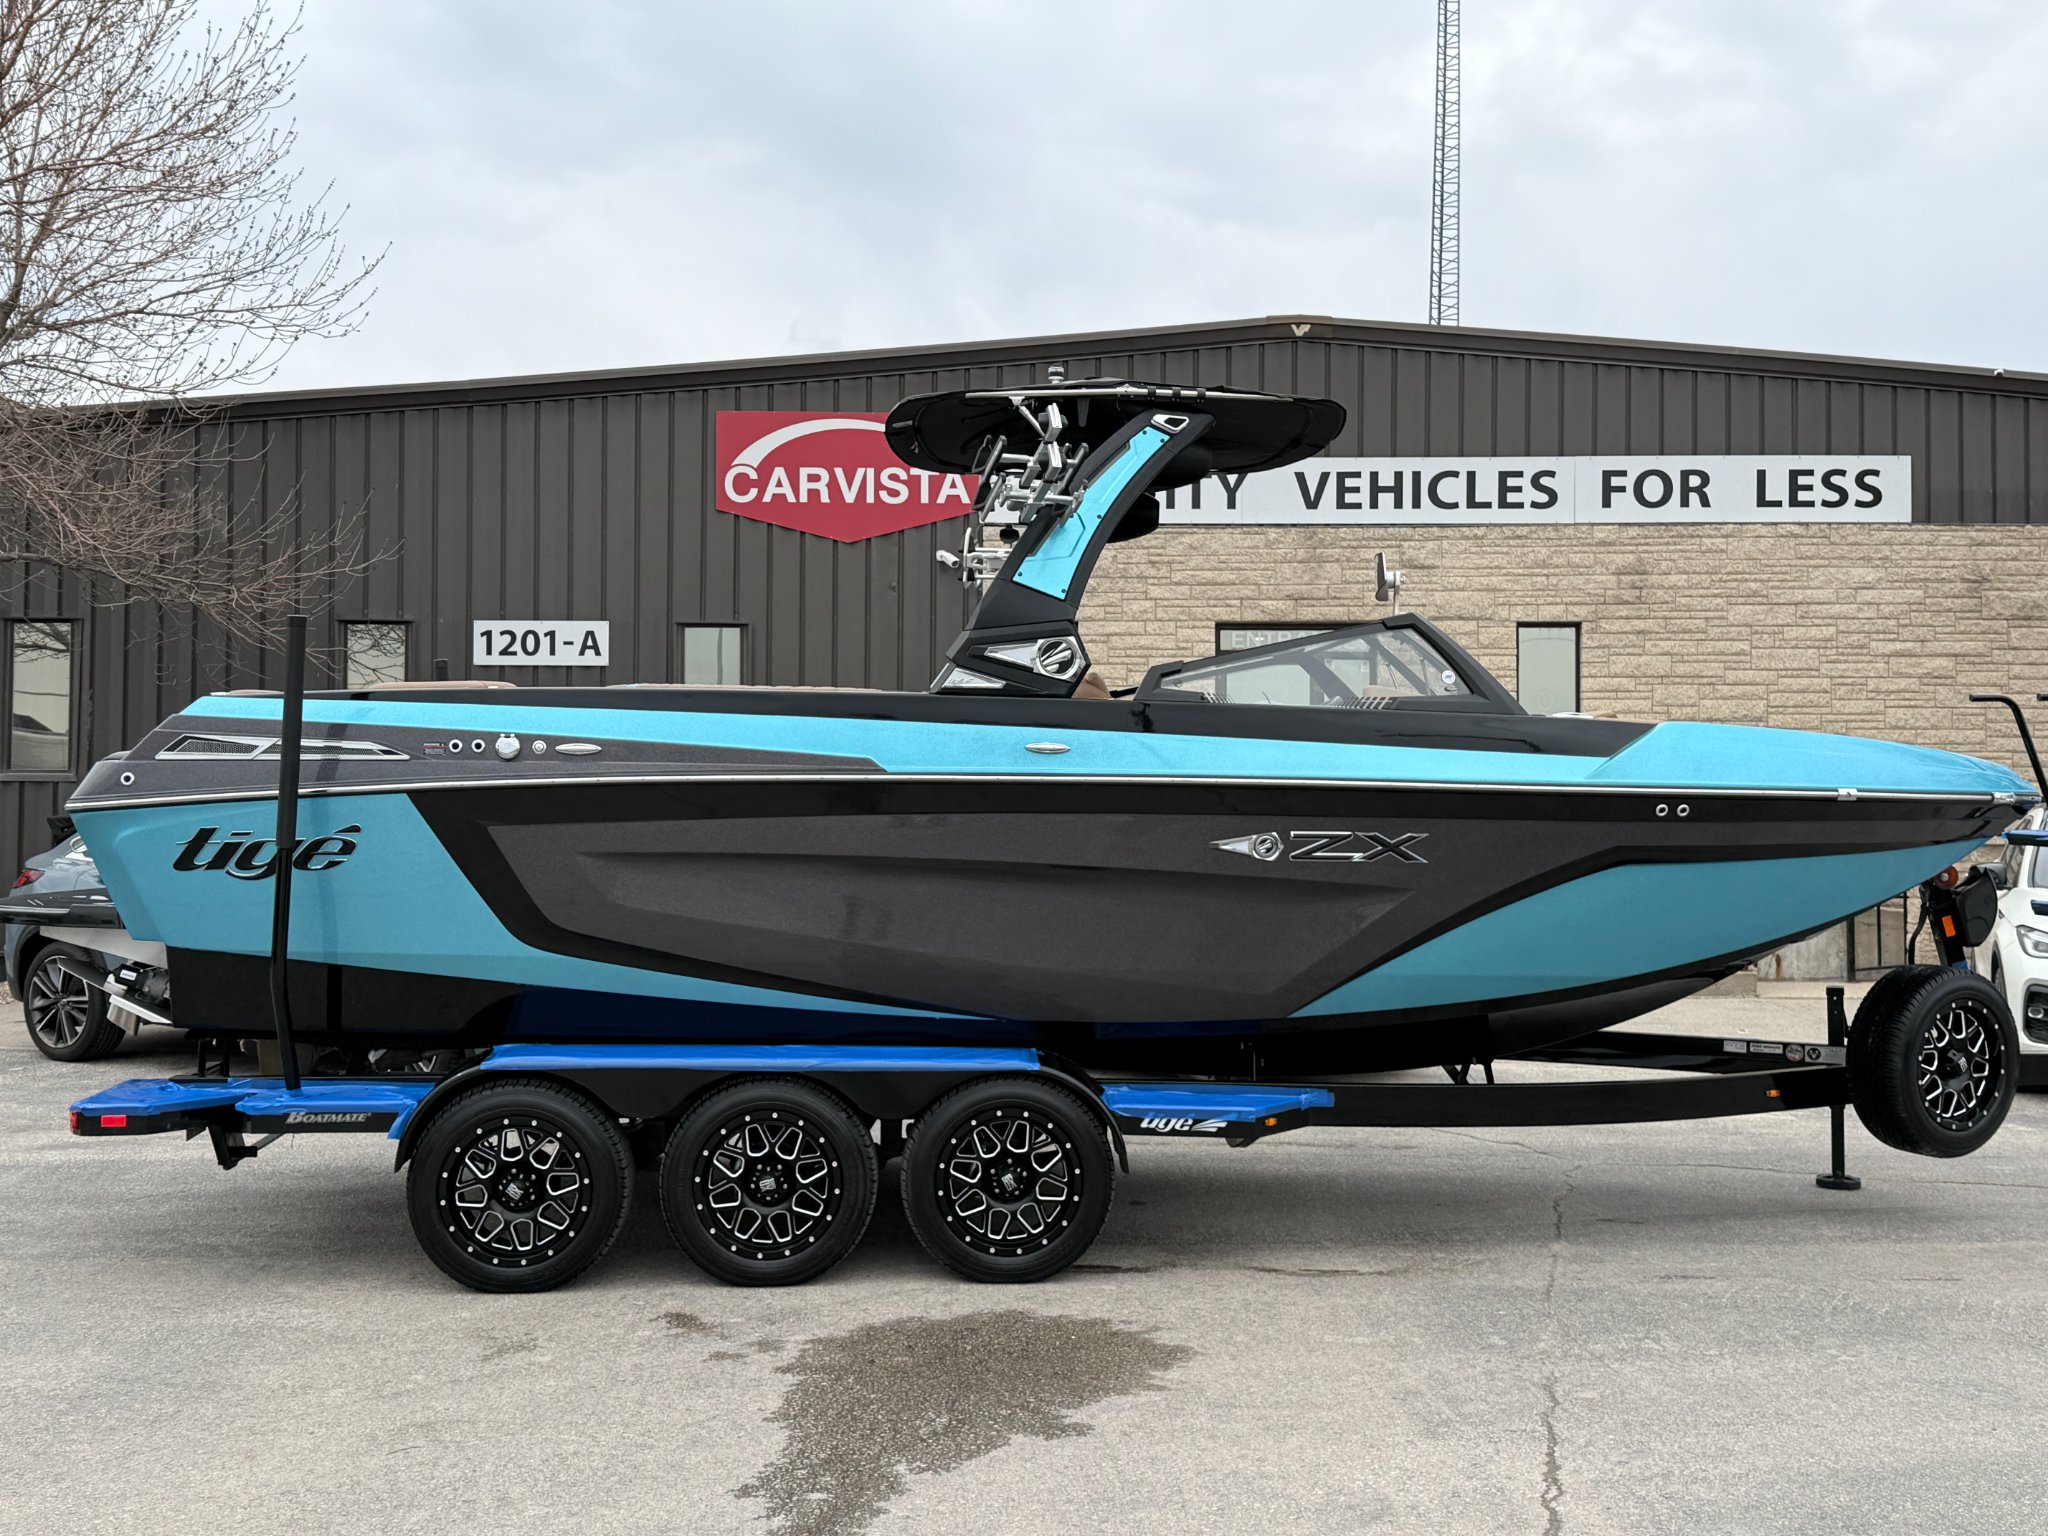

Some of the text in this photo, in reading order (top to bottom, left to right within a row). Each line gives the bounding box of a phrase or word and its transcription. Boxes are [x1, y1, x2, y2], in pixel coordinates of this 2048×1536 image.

[724, 465, 971, 504] CARVISTA
[1294, 469, 1559, 510] VEHICLES
[1601, 468, 1712, 509] FOR
[1756, 468, 1884, 508] LESS
[480, 629, 602, 656] 1201-A
